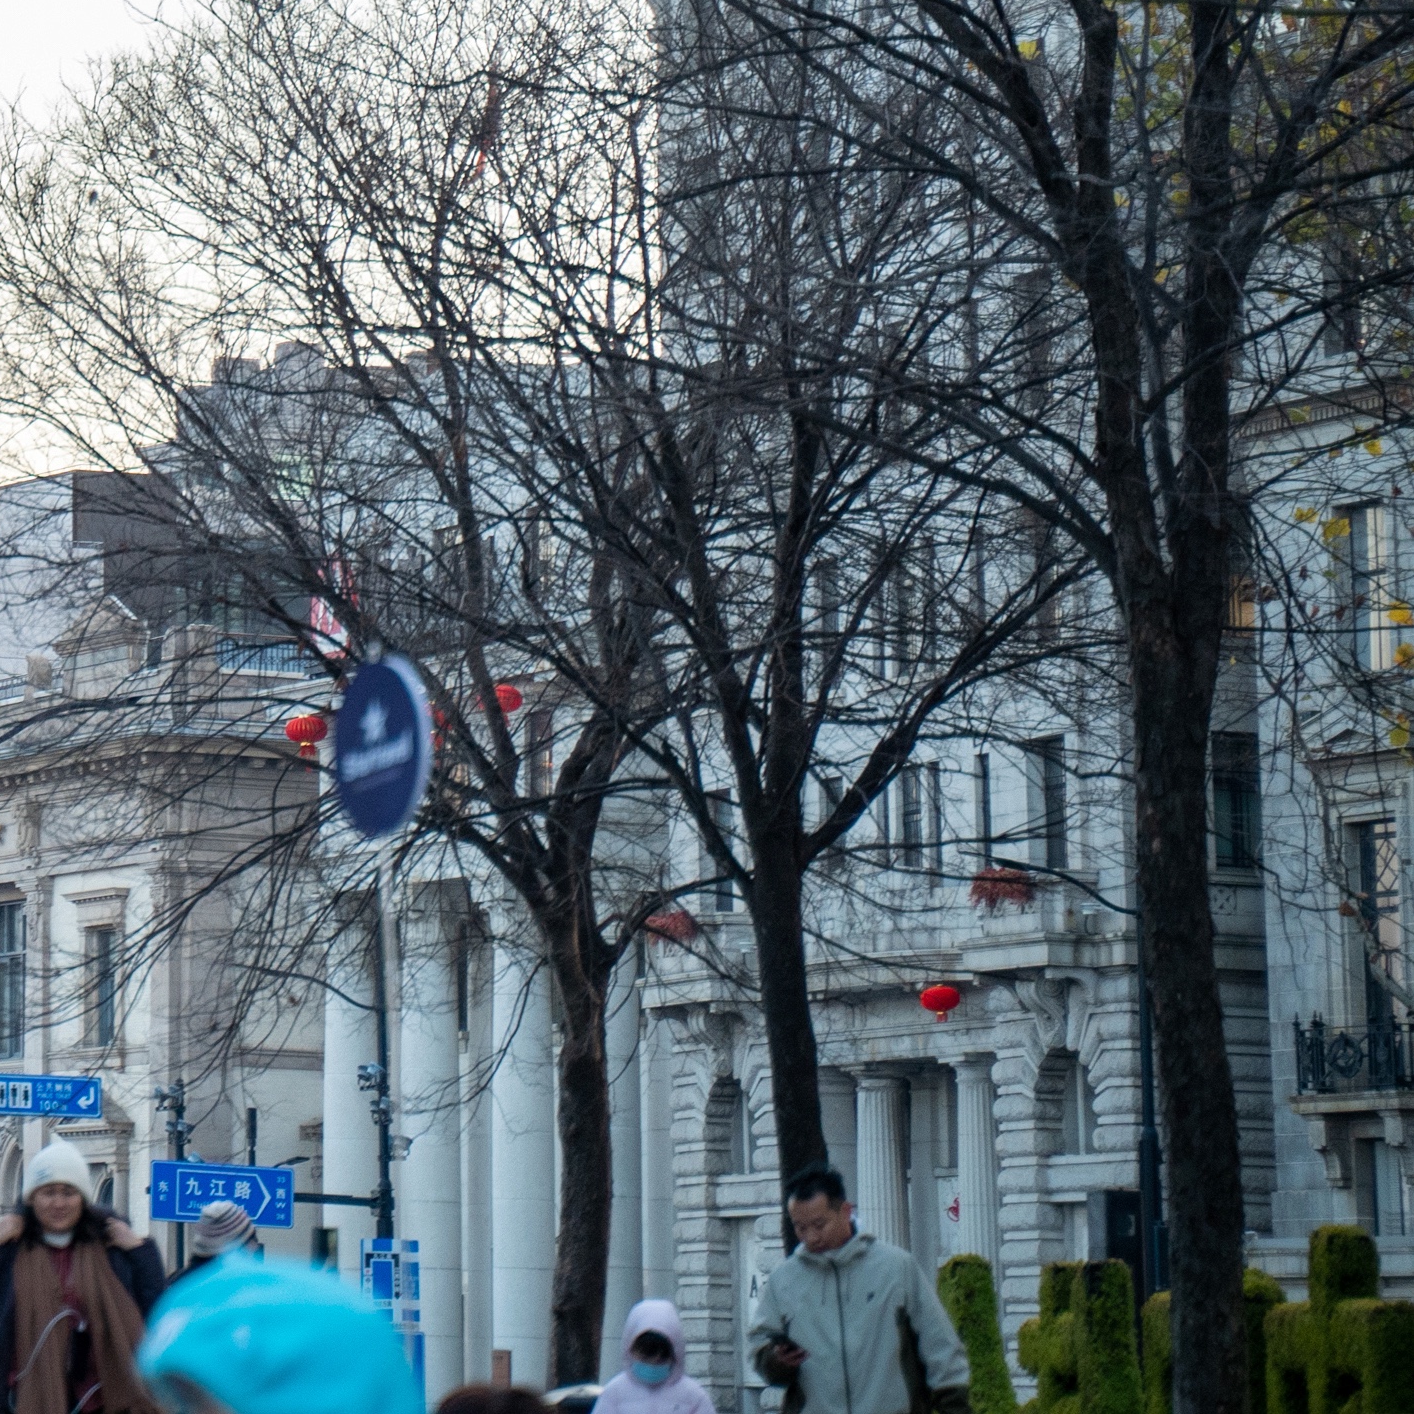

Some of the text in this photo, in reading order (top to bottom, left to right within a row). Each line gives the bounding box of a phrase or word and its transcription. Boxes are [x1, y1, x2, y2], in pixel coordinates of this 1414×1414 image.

[157, 1180, 169, 1193] 东
[185, 1177, 252, 1200] 九江路
[275, 1188, 286, 1200] 西
